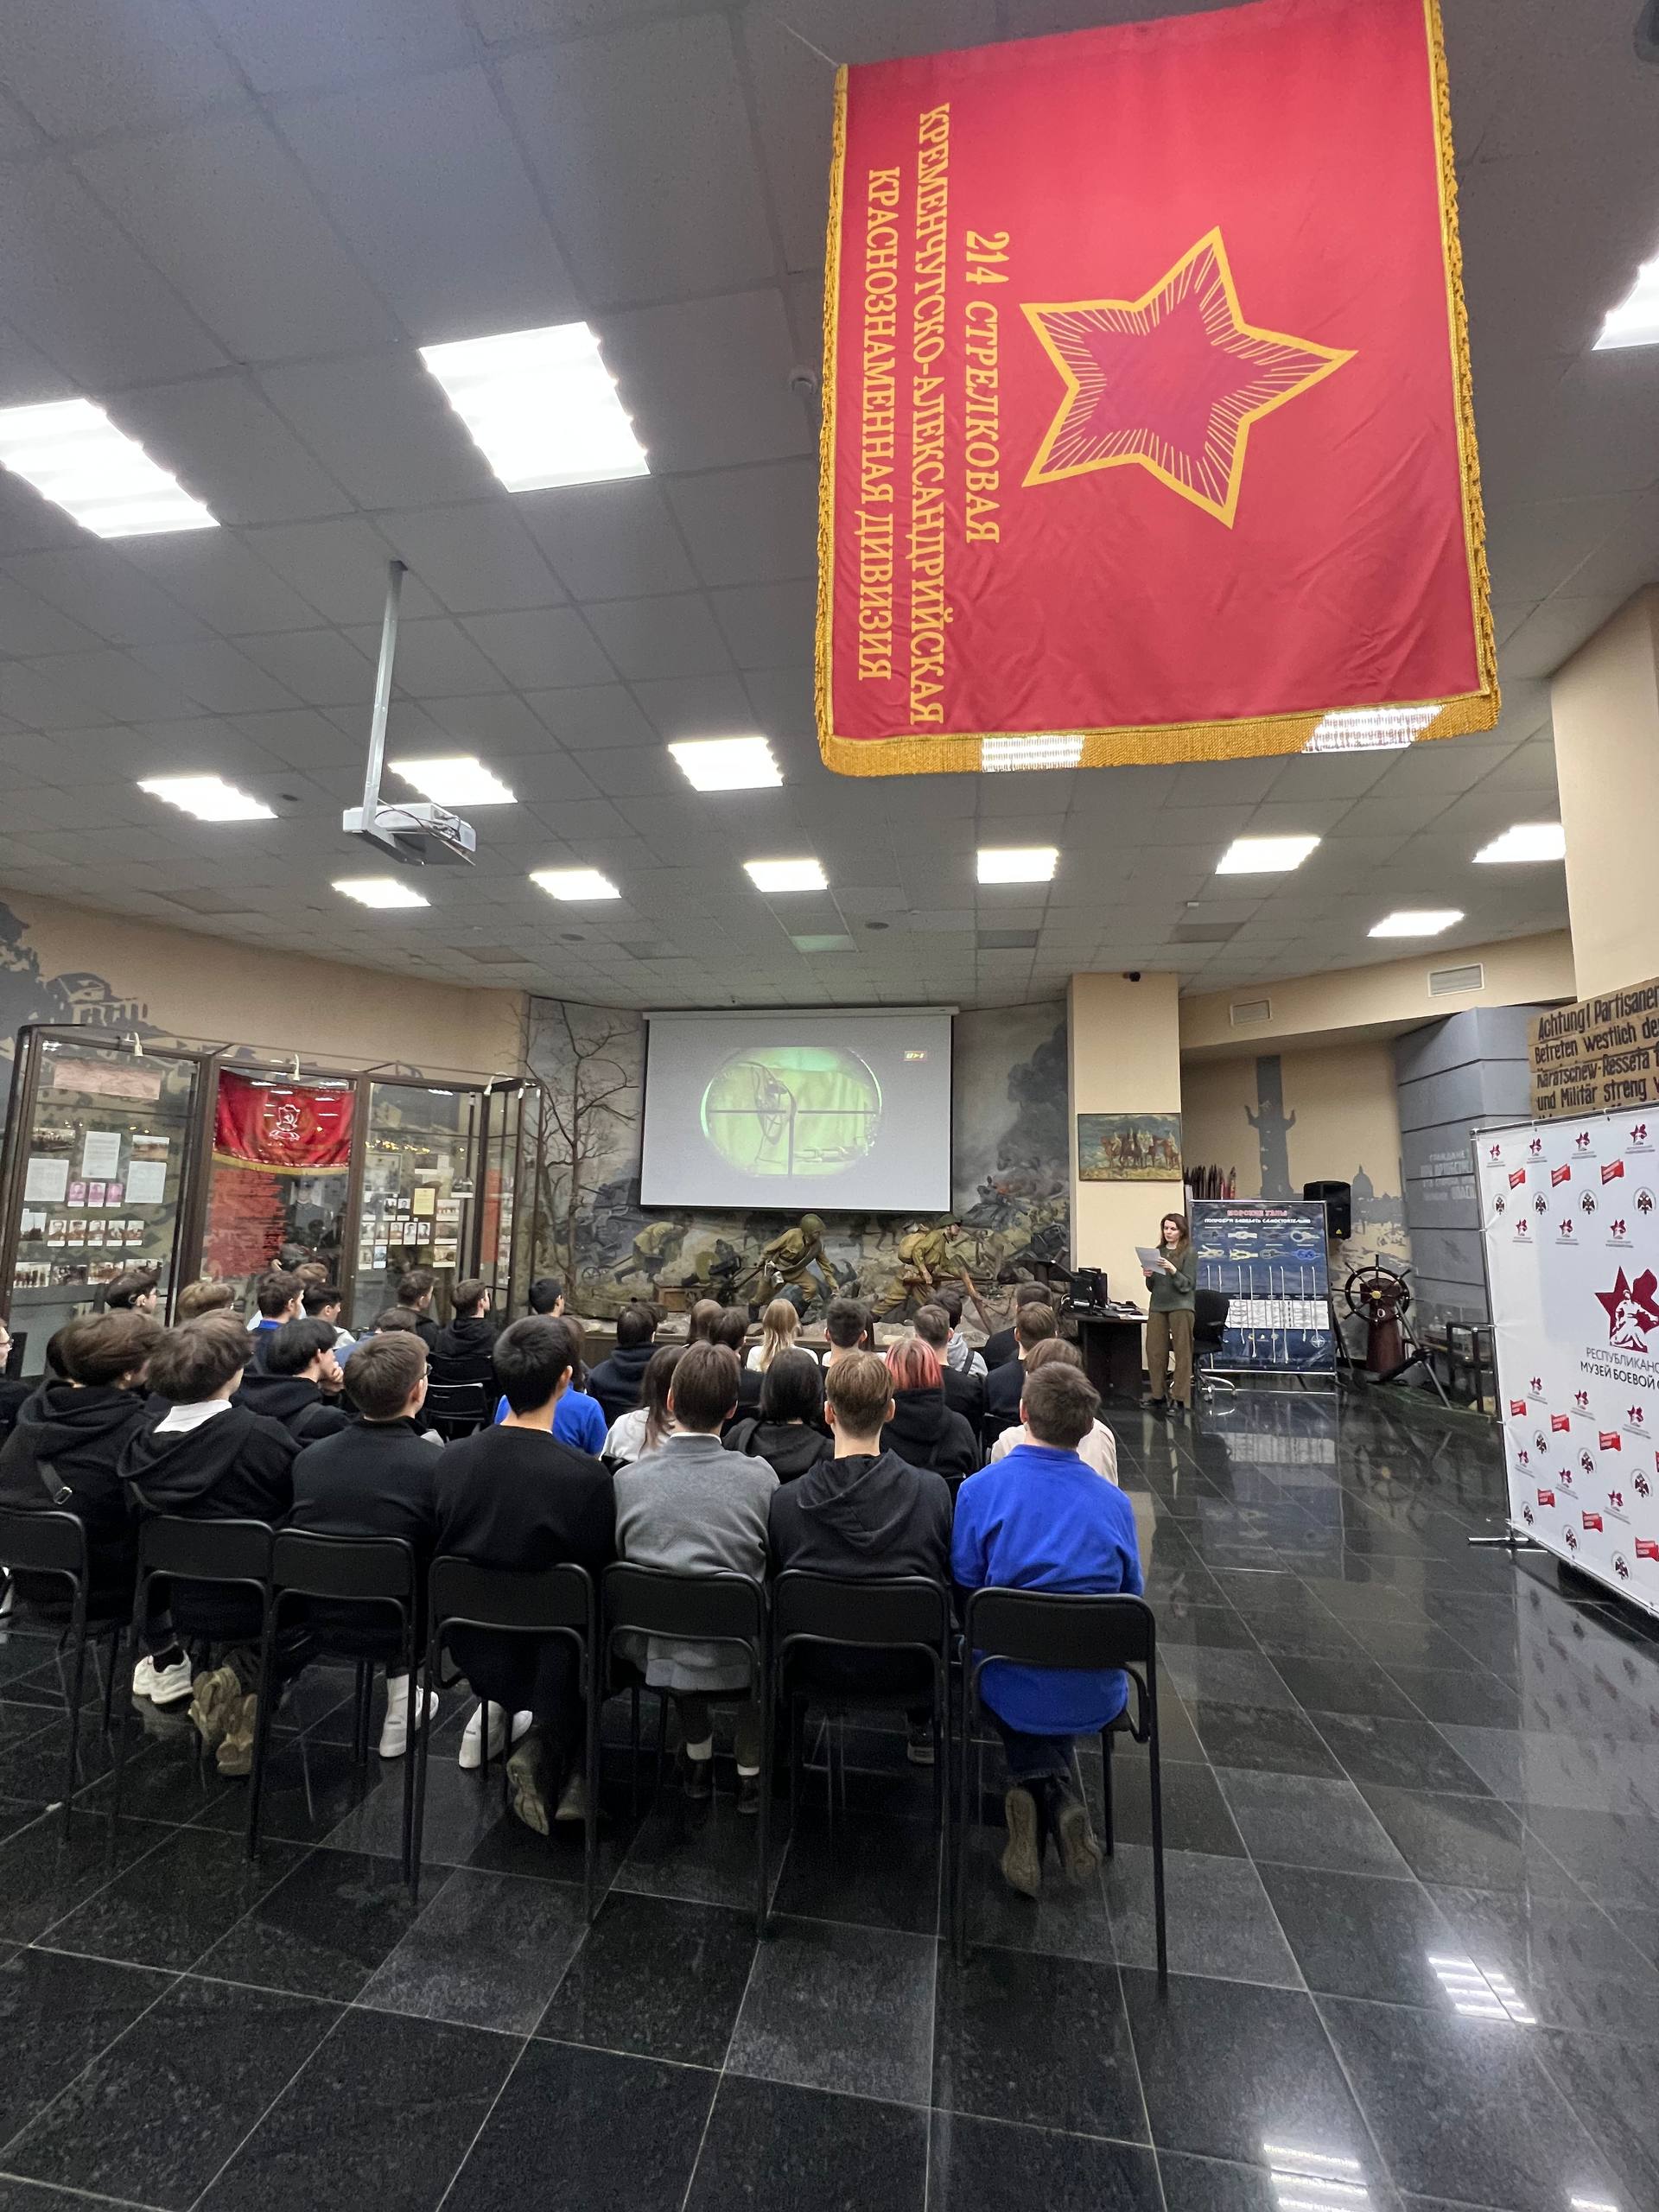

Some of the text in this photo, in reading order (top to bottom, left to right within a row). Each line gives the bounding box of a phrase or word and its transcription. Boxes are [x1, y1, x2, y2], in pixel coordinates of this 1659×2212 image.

[964, 230, 1010, 544] 214 СТРЕЛКОВАЯ
[854, 166, 900, 681] КРАСНОЗНАМЕННАЯ ДИВИЗИЯ
[1535, 1039, 1579, 1065] Betreten
[1643, 1016, 1659, 1039] de
[1538, 1002, 1591, 1041] Achtung!
[1537, 1090, 1556, 1111] und
[1561, 1083, 1599, 1108] Militär
[1603, 1077, 1648, 1102] streng
[1580, 1360, 1612, 1379] МУЗЕЙ
[1613, 1369, 1656, 1390] БОЕВОЙ
